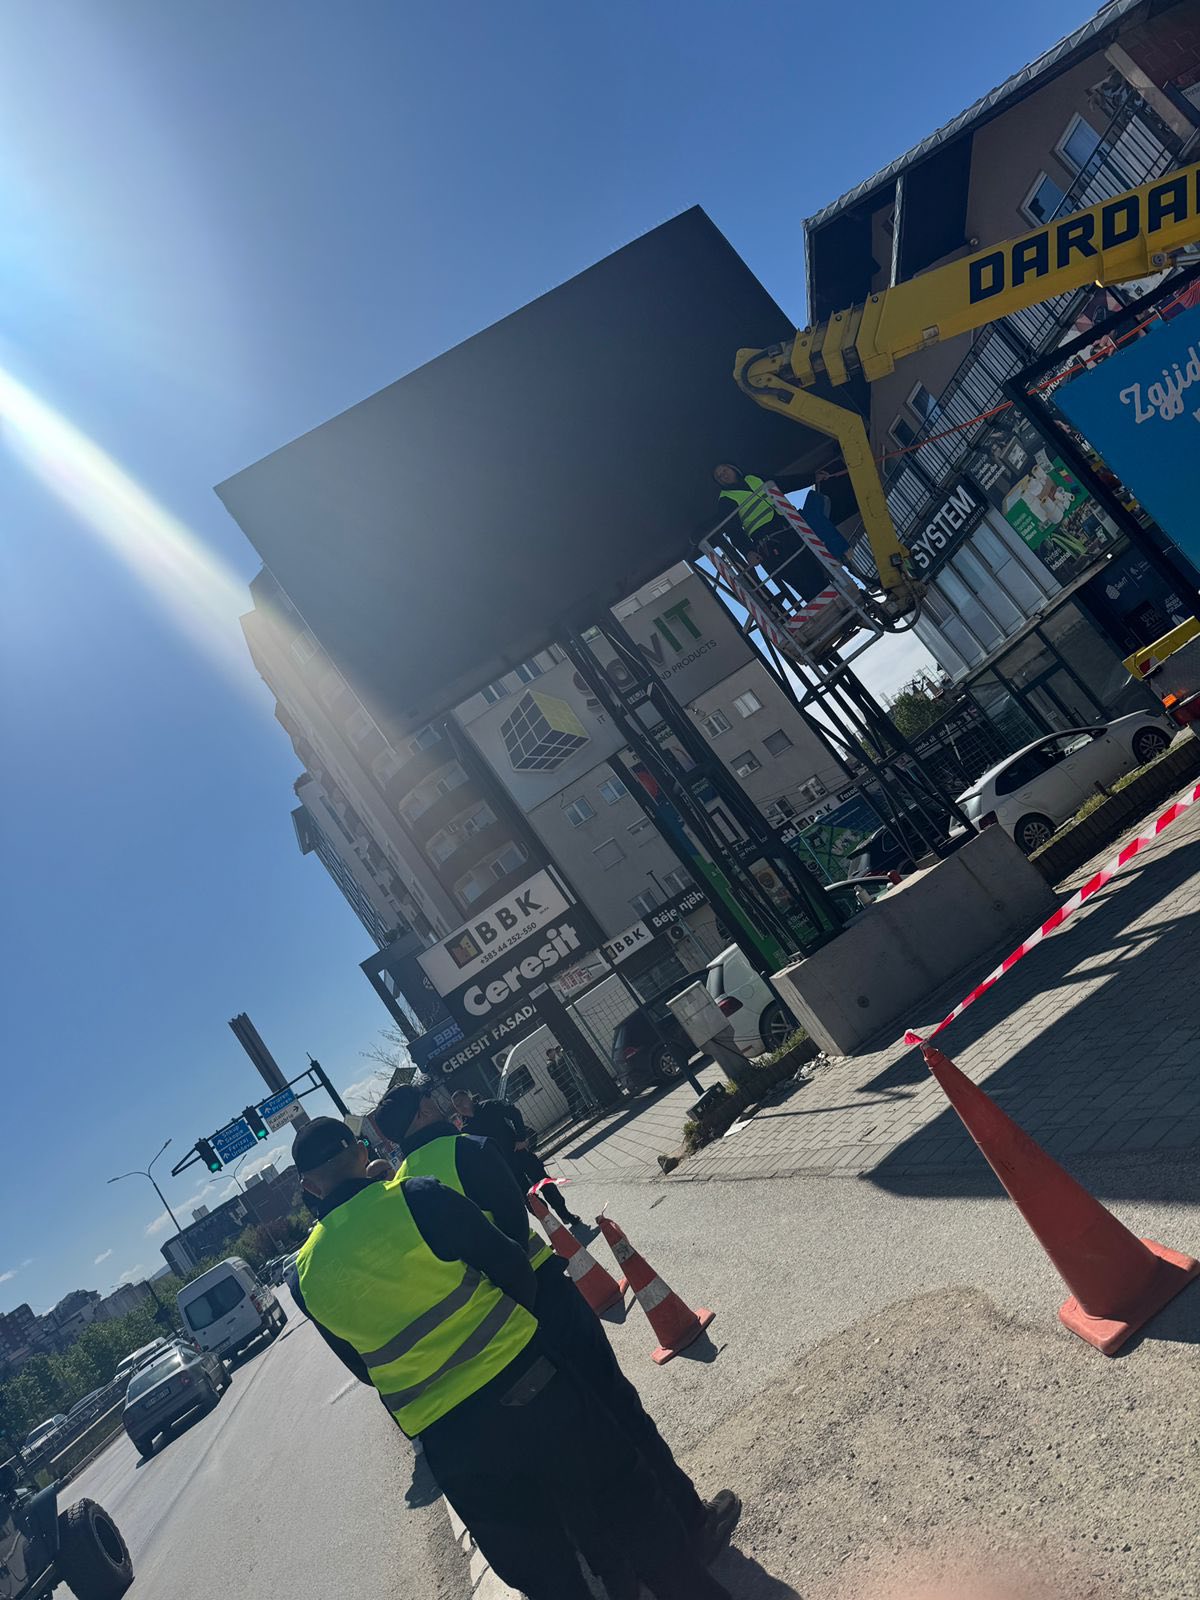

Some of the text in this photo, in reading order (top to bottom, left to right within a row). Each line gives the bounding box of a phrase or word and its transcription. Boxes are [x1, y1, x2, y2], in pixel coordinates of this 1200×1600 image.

[1119, 342, 1200, 424] Zgjid
[910, 485, 977, 569] SYSTEM
[659, 670, 673, 681] ND
[672, 639, 718, 674] PRODUCTS
[473, 888, 543, 946] BBK
[652, 891, 705, 928] Bëje njëh
[480, 922, 538, 965] +383 44 252-550
[613, 928, 646, 953] BBK
[463, 923, 581, 1016] Ceresit
[442, 1034, 491, 1074] CERESIT
